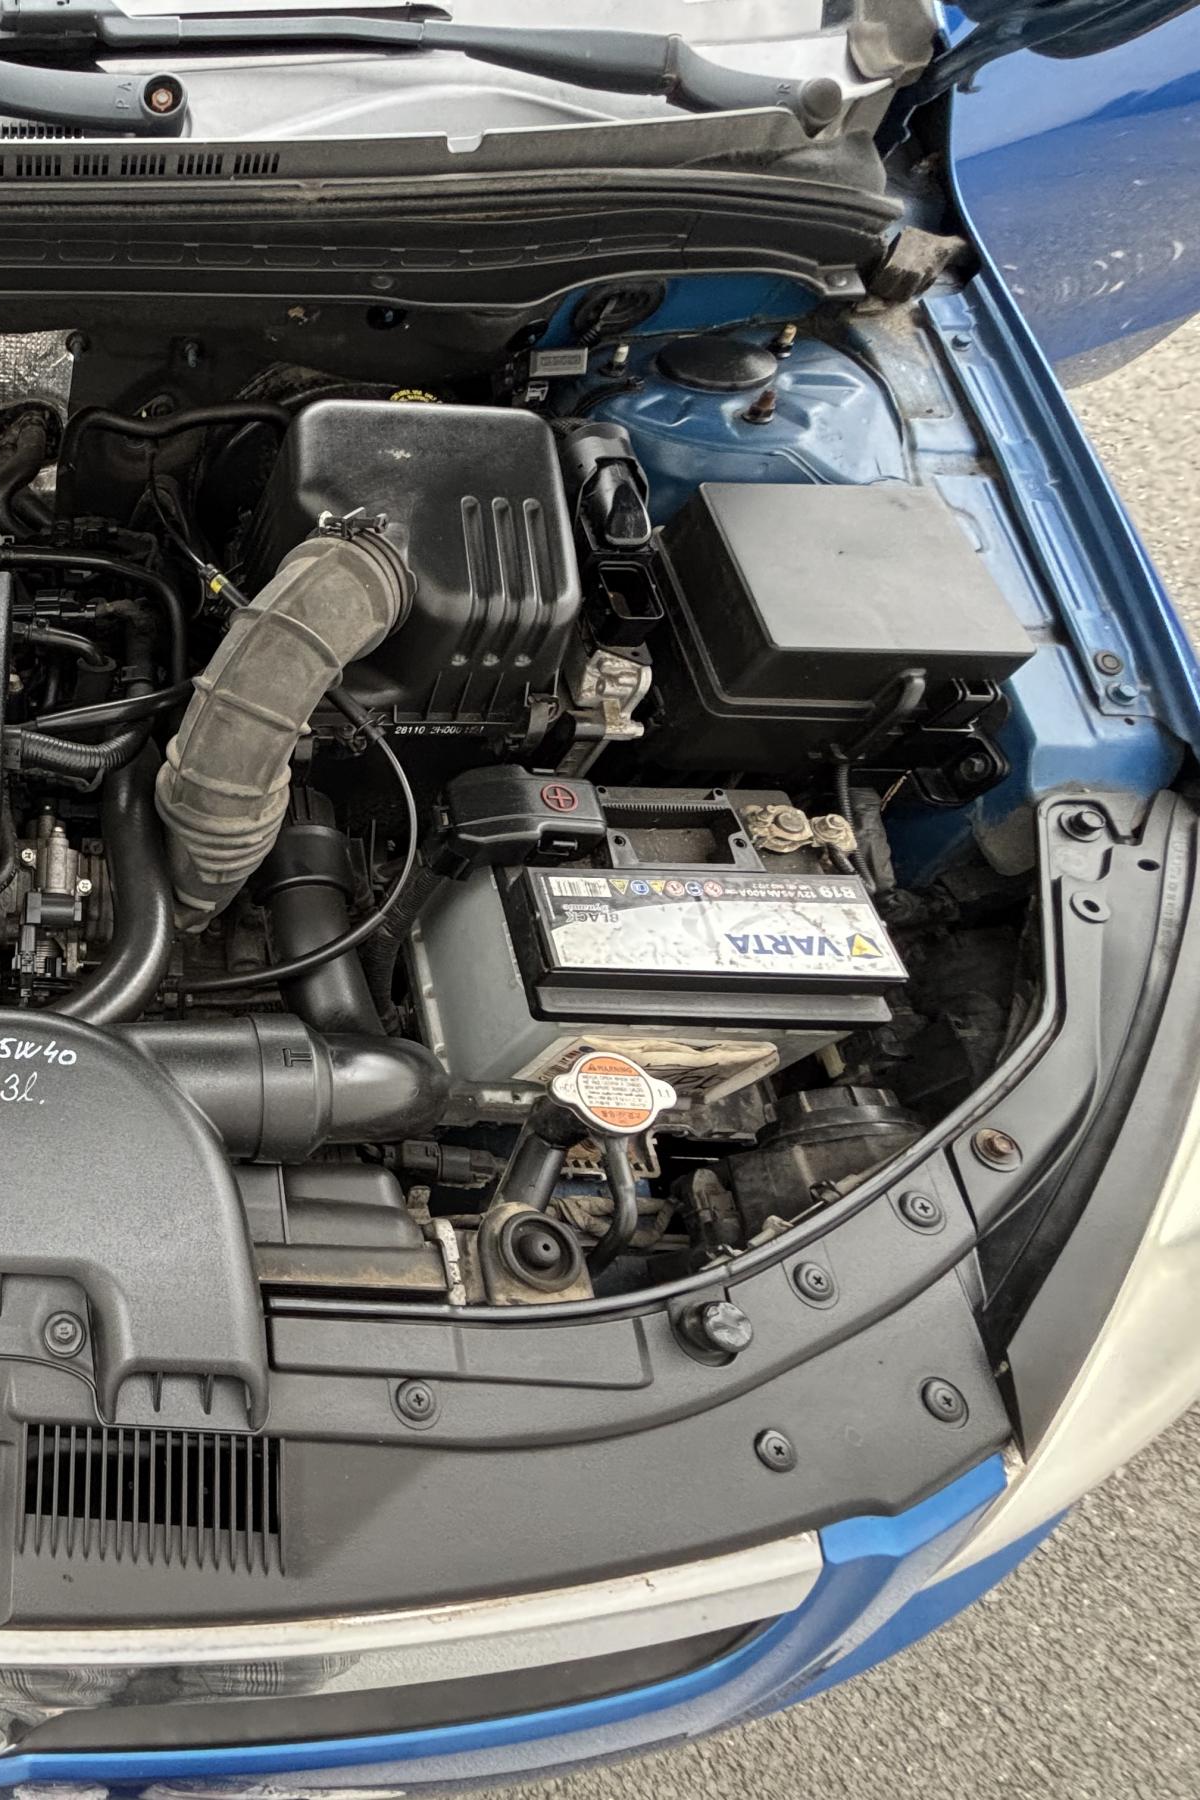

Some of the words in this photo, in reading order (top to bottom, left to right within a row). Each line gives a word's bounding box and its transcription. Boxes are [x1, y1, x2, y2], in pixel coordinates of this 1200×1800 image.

[394, 725, 426, 735] 28110
[796, 889, 817, 899] 12V
[819, 885, 857, 900] B19
[564, 911, 620, 924] BLACK
[723, 932, 845, 958] VARTA
[595, 1064, 633, 1074] WARNING
